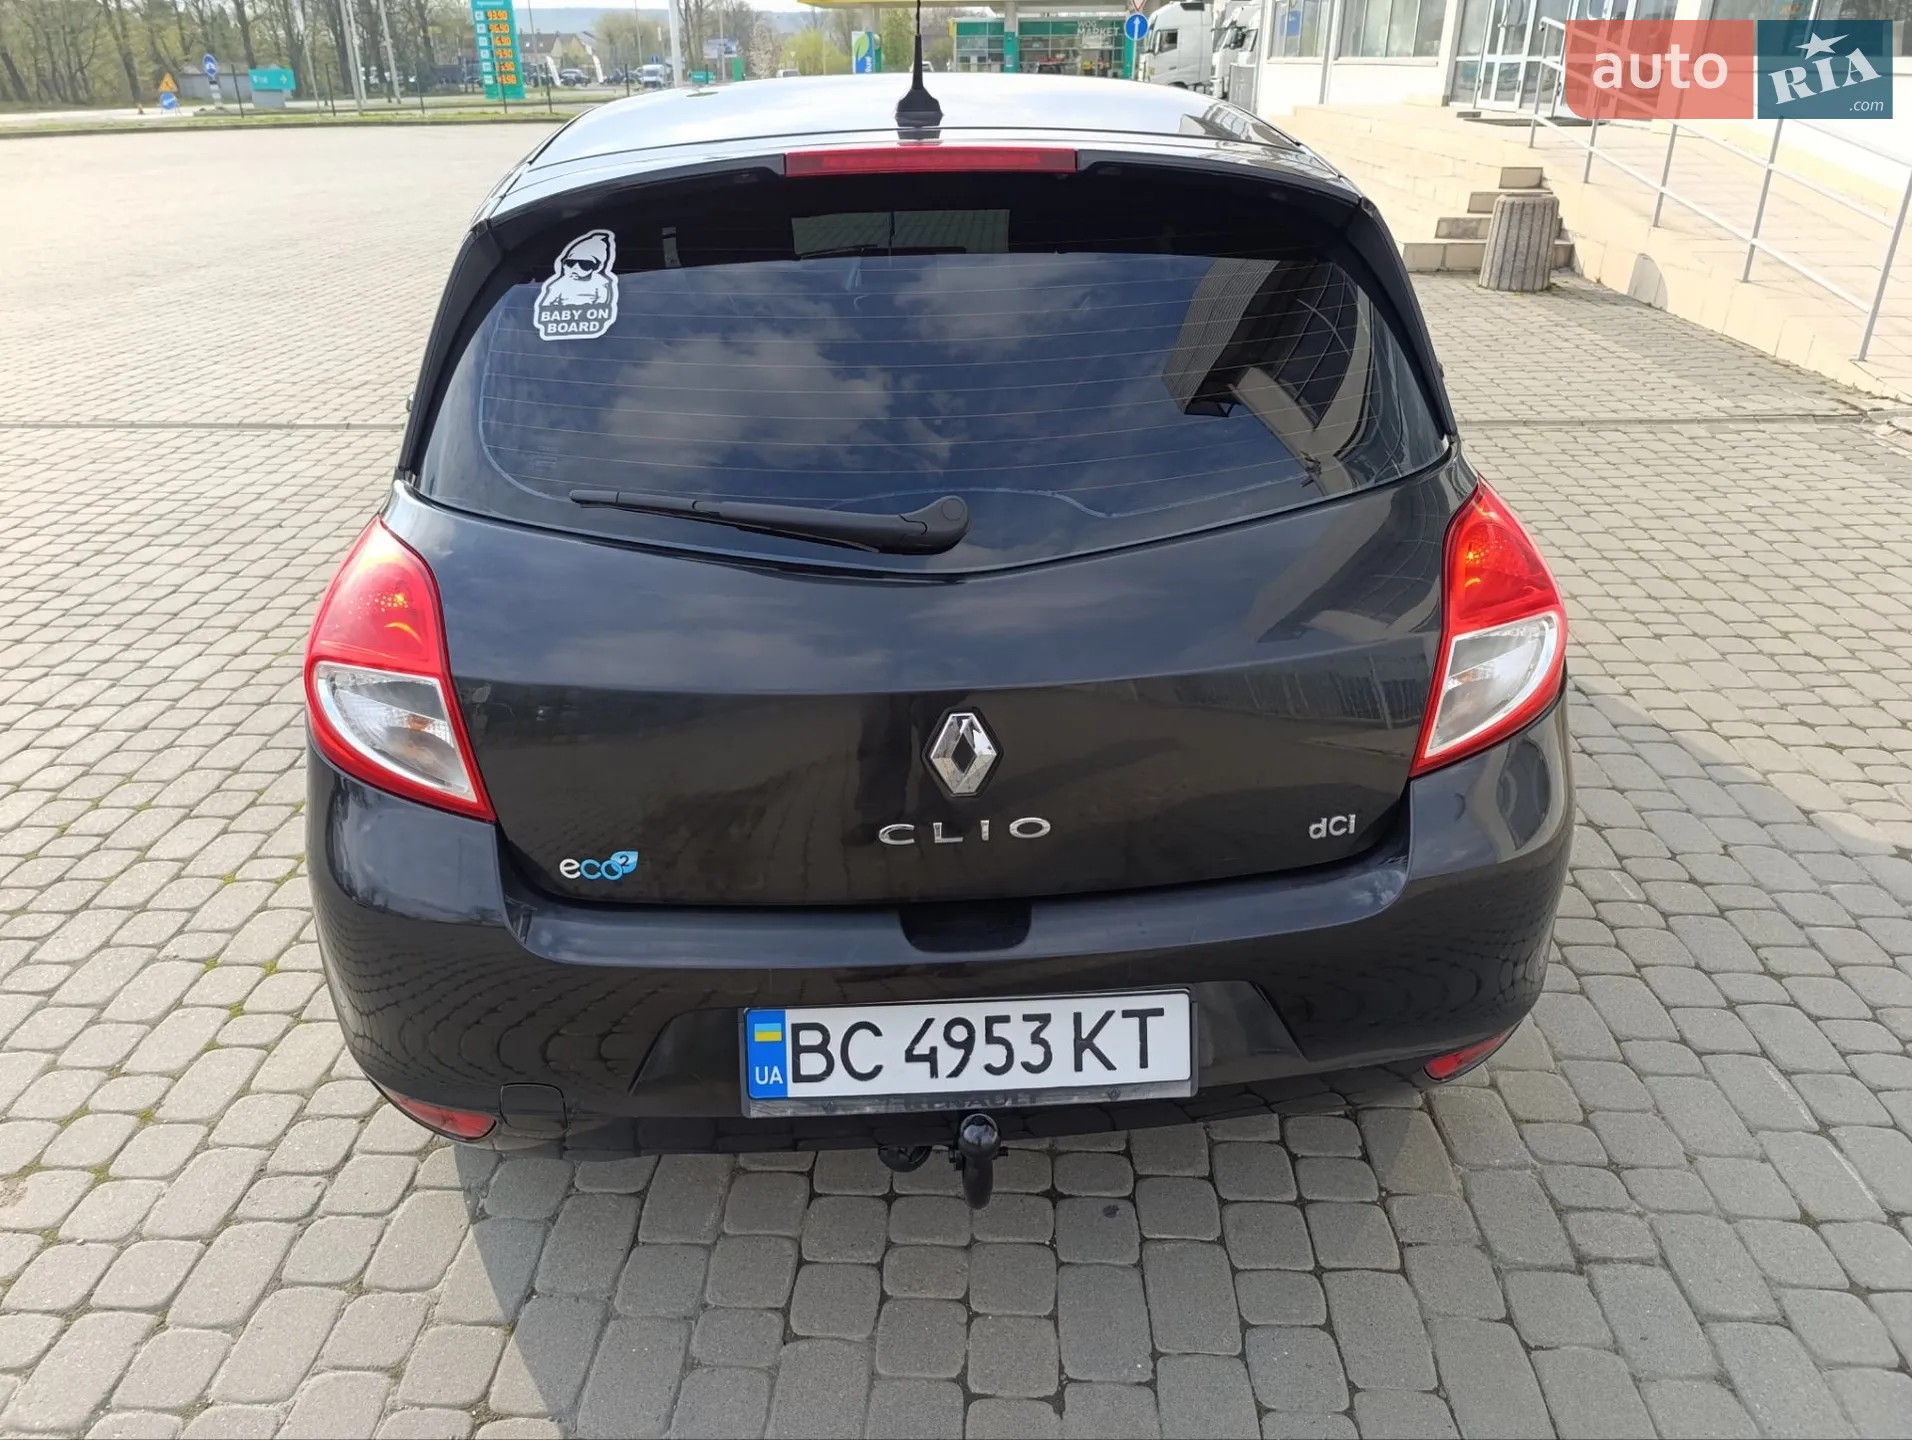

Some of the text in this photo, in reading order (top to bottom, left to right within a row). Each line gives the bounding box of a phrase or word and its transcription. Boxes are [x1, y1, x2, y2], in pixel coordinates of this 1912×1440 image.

[1077, 27, 1120, 37] MARKET
[541, 308, 609, 321] BABY ON
[547, 321, 600, 333] BOARD
[878, 816, 1051, 846] CLIO
[790, 1007, 1165, 1083] BC 4953 KT
[755, 1066, 784, 1085] UA
